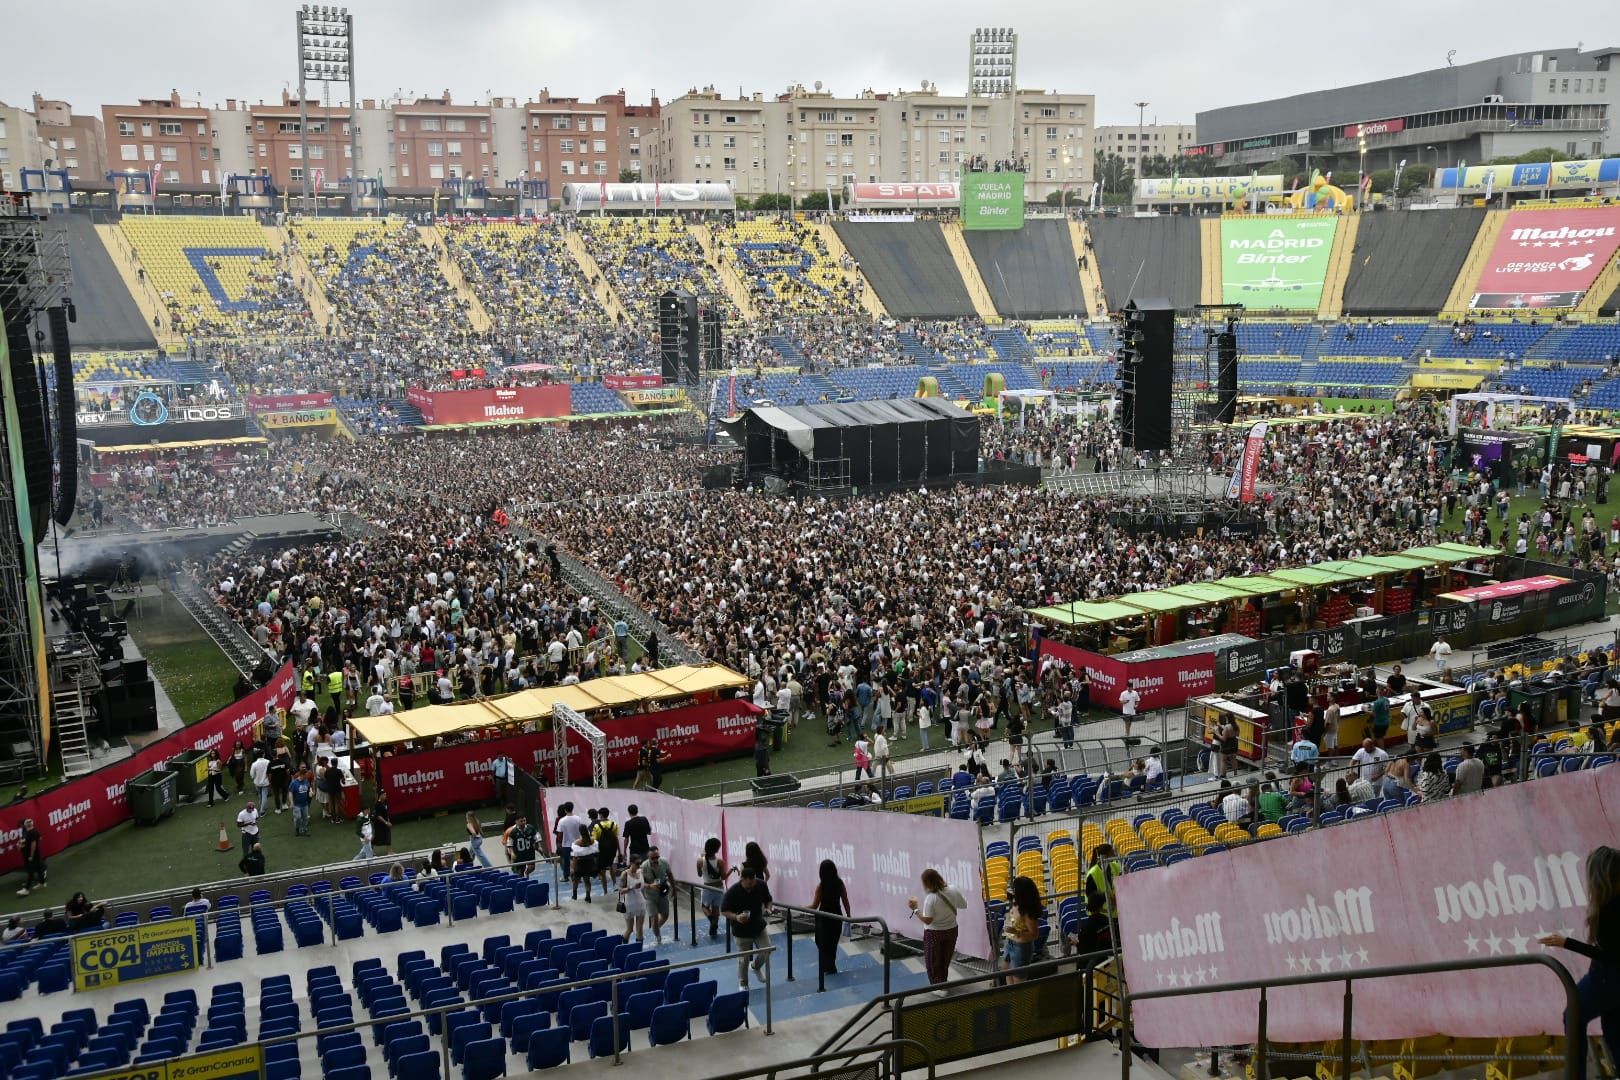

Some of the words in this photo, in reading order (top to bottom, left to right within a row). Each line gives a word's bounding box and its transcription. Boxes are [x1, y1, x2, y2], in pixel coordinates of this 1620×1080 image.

[878, 185, 954, 196] SPAR
[977, 183, 1001, 192] VUELA
[1004, 183, 1011, 191] A
[977, 191, 1012, 200] MADRID
[979, 206, 1009, 216] Binter
[1269, 229, 1286, 239] A
[1510, 226, 1616, 240] Mahou
[1229, 238, 1324, 249] MADRID
[1236, 253, 1313, 264] Binter
[183, 407, 232, 421] IQOS
[484, 404, 524, 417] Mahou
[78, 414, 106, 424] VEEV
[281, 413, 316, 425] BAÑOS
[1178, 669, 1213, 682] Mahou
[232, 711, 257, 733] Mahou
[656, 724, 700, 740] Mahou
[606, 735, 639, 749] ahou
[393, 768, 444, 788] Mahou
[48, 799, 91, 826] Mahou
[89, 933, 136, 950] SECTOR
[80, 943, 140, 971] C04
[186, 1056, 255, 1077] GranCanaria
